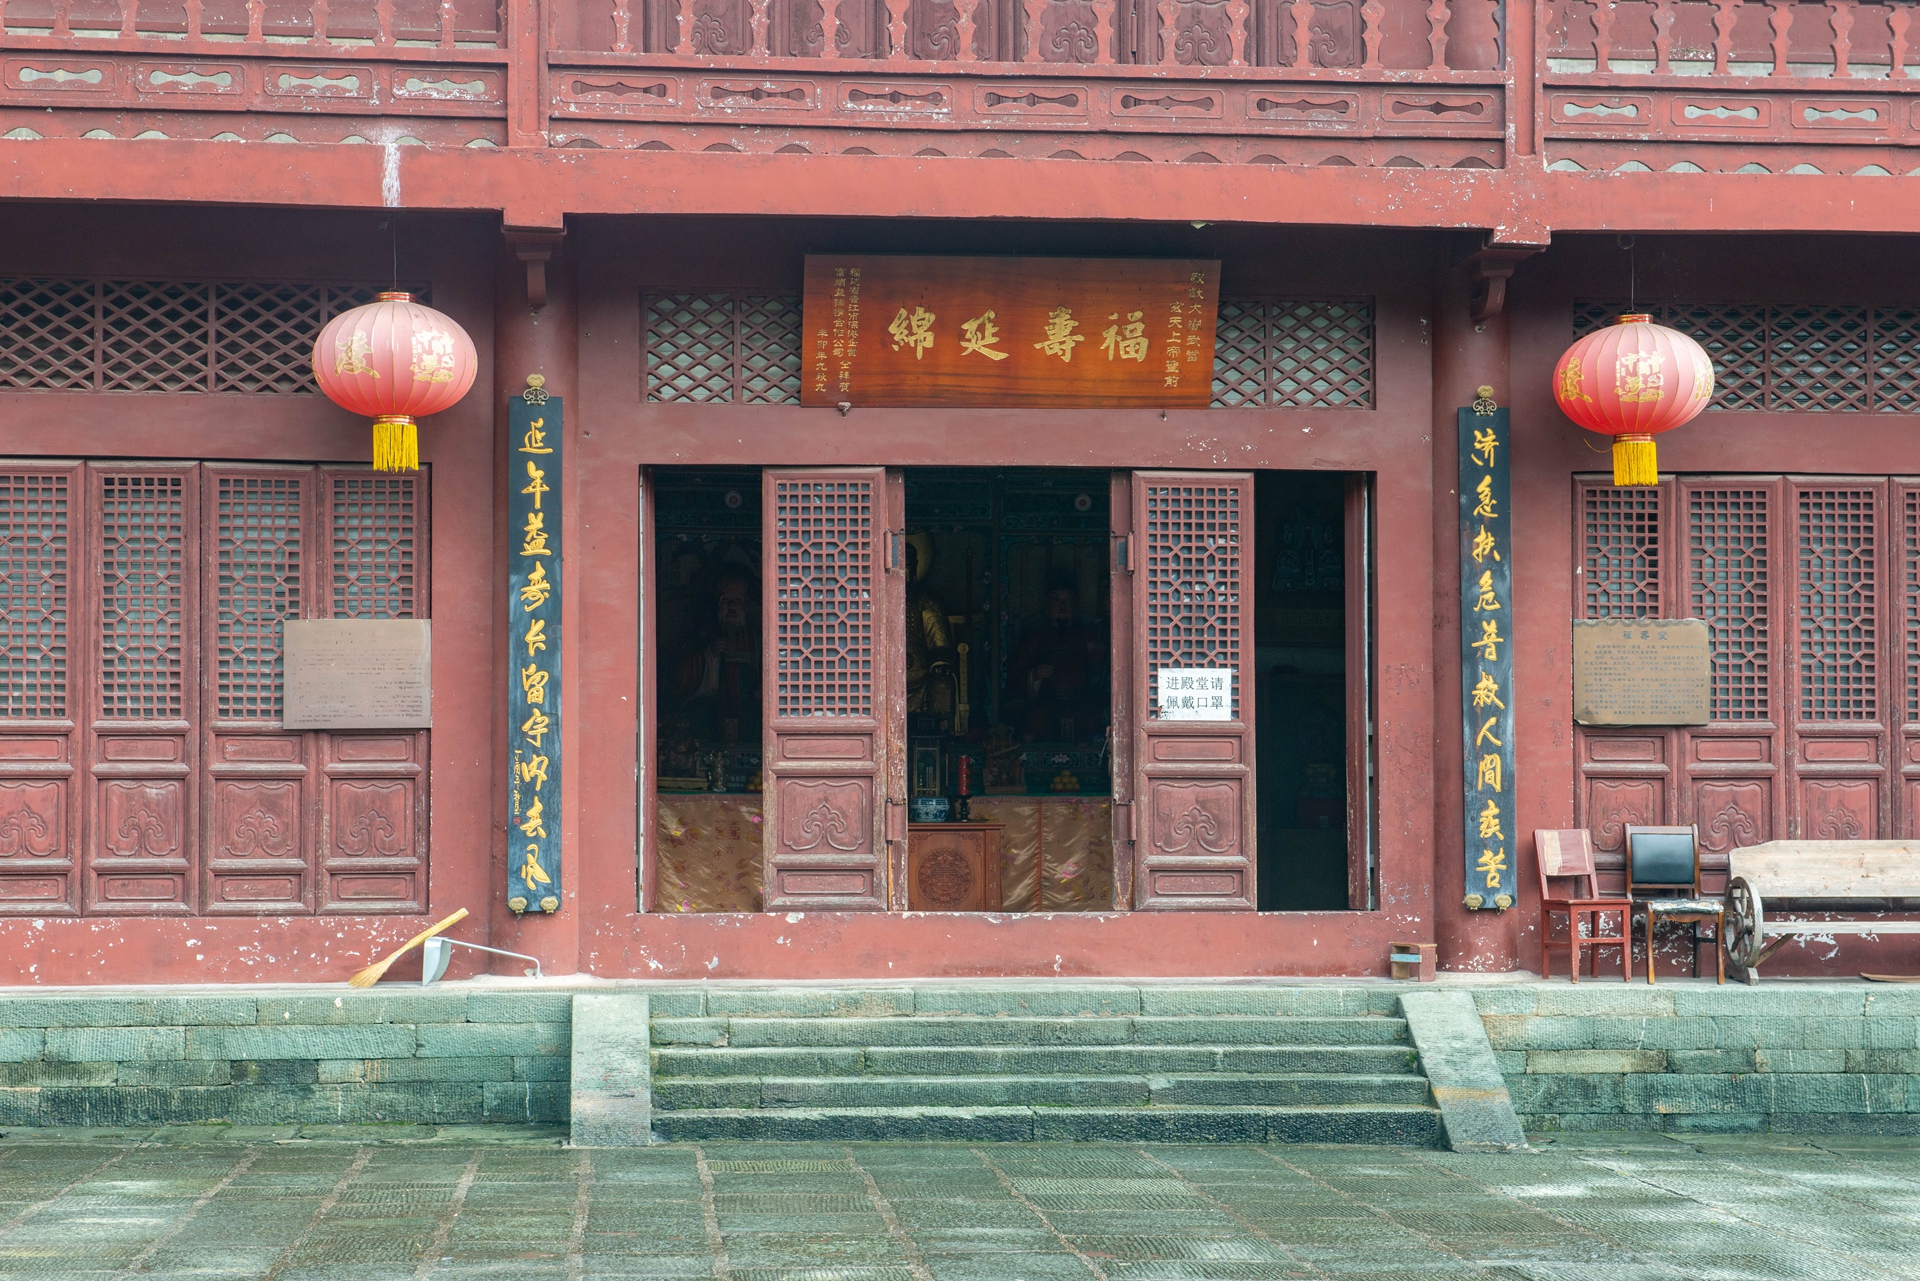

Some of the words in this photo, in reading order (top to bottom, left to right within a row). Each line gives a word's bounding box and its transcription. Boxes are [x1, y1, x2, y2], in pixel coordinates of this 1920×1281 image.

[1165, 676, 1224, 691] 进殿堂请
[1166, 695, 1224, 710] 佩戴口罩
